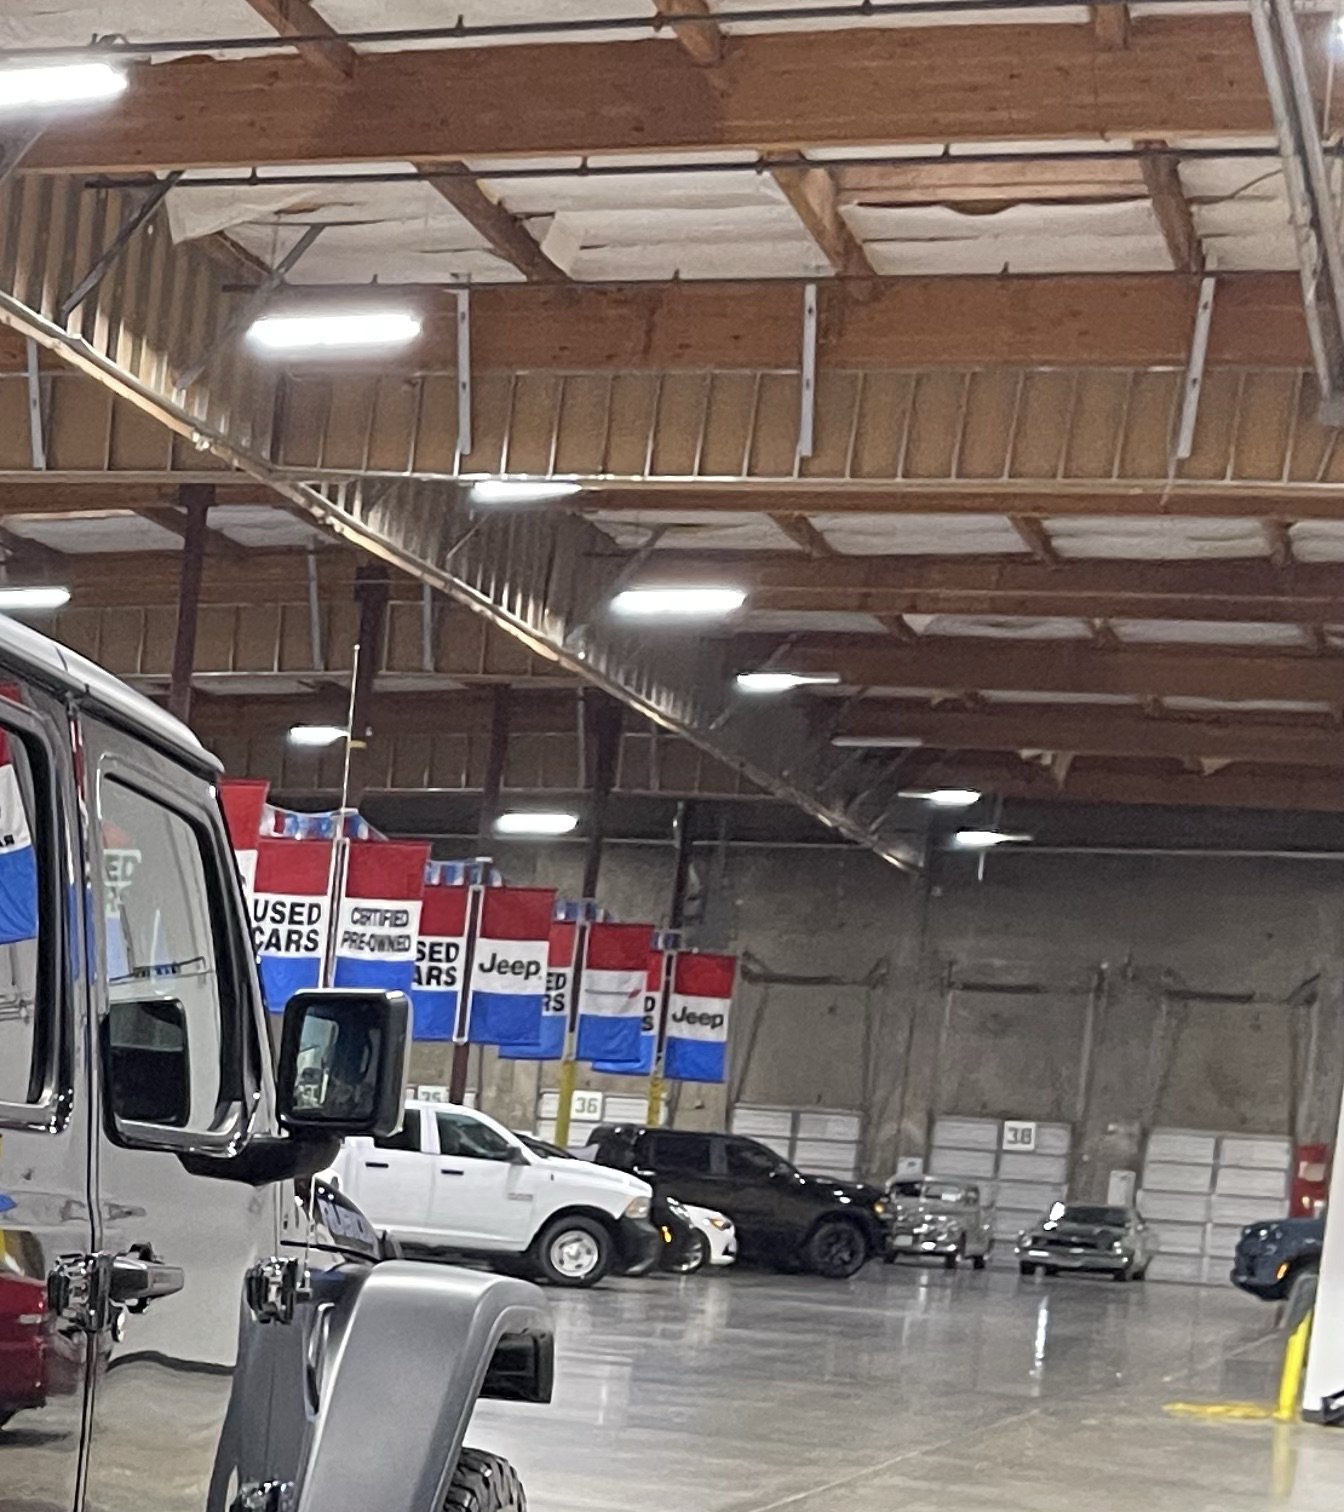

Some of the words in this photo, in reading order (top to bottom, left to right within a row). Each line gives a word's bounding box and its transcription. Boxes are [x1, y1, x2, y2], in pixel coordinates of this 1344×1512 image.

[253, 899, 321, 925] USED
[351, 907, 409, 927] CERTIFIED
[252, 926, 319, 952] CARS
[341, 931, 411, 952] PRE-OWNED
[416, 941, 460, 963] SED
[413, 966, 457, 986] ARS
[479, 952, 541, 980] Jeep
[672, 1006, 724, 1029] Jeep
[575, 1097, 598, 1114] 36
[1007, 1127, 1032, 1145] 38
